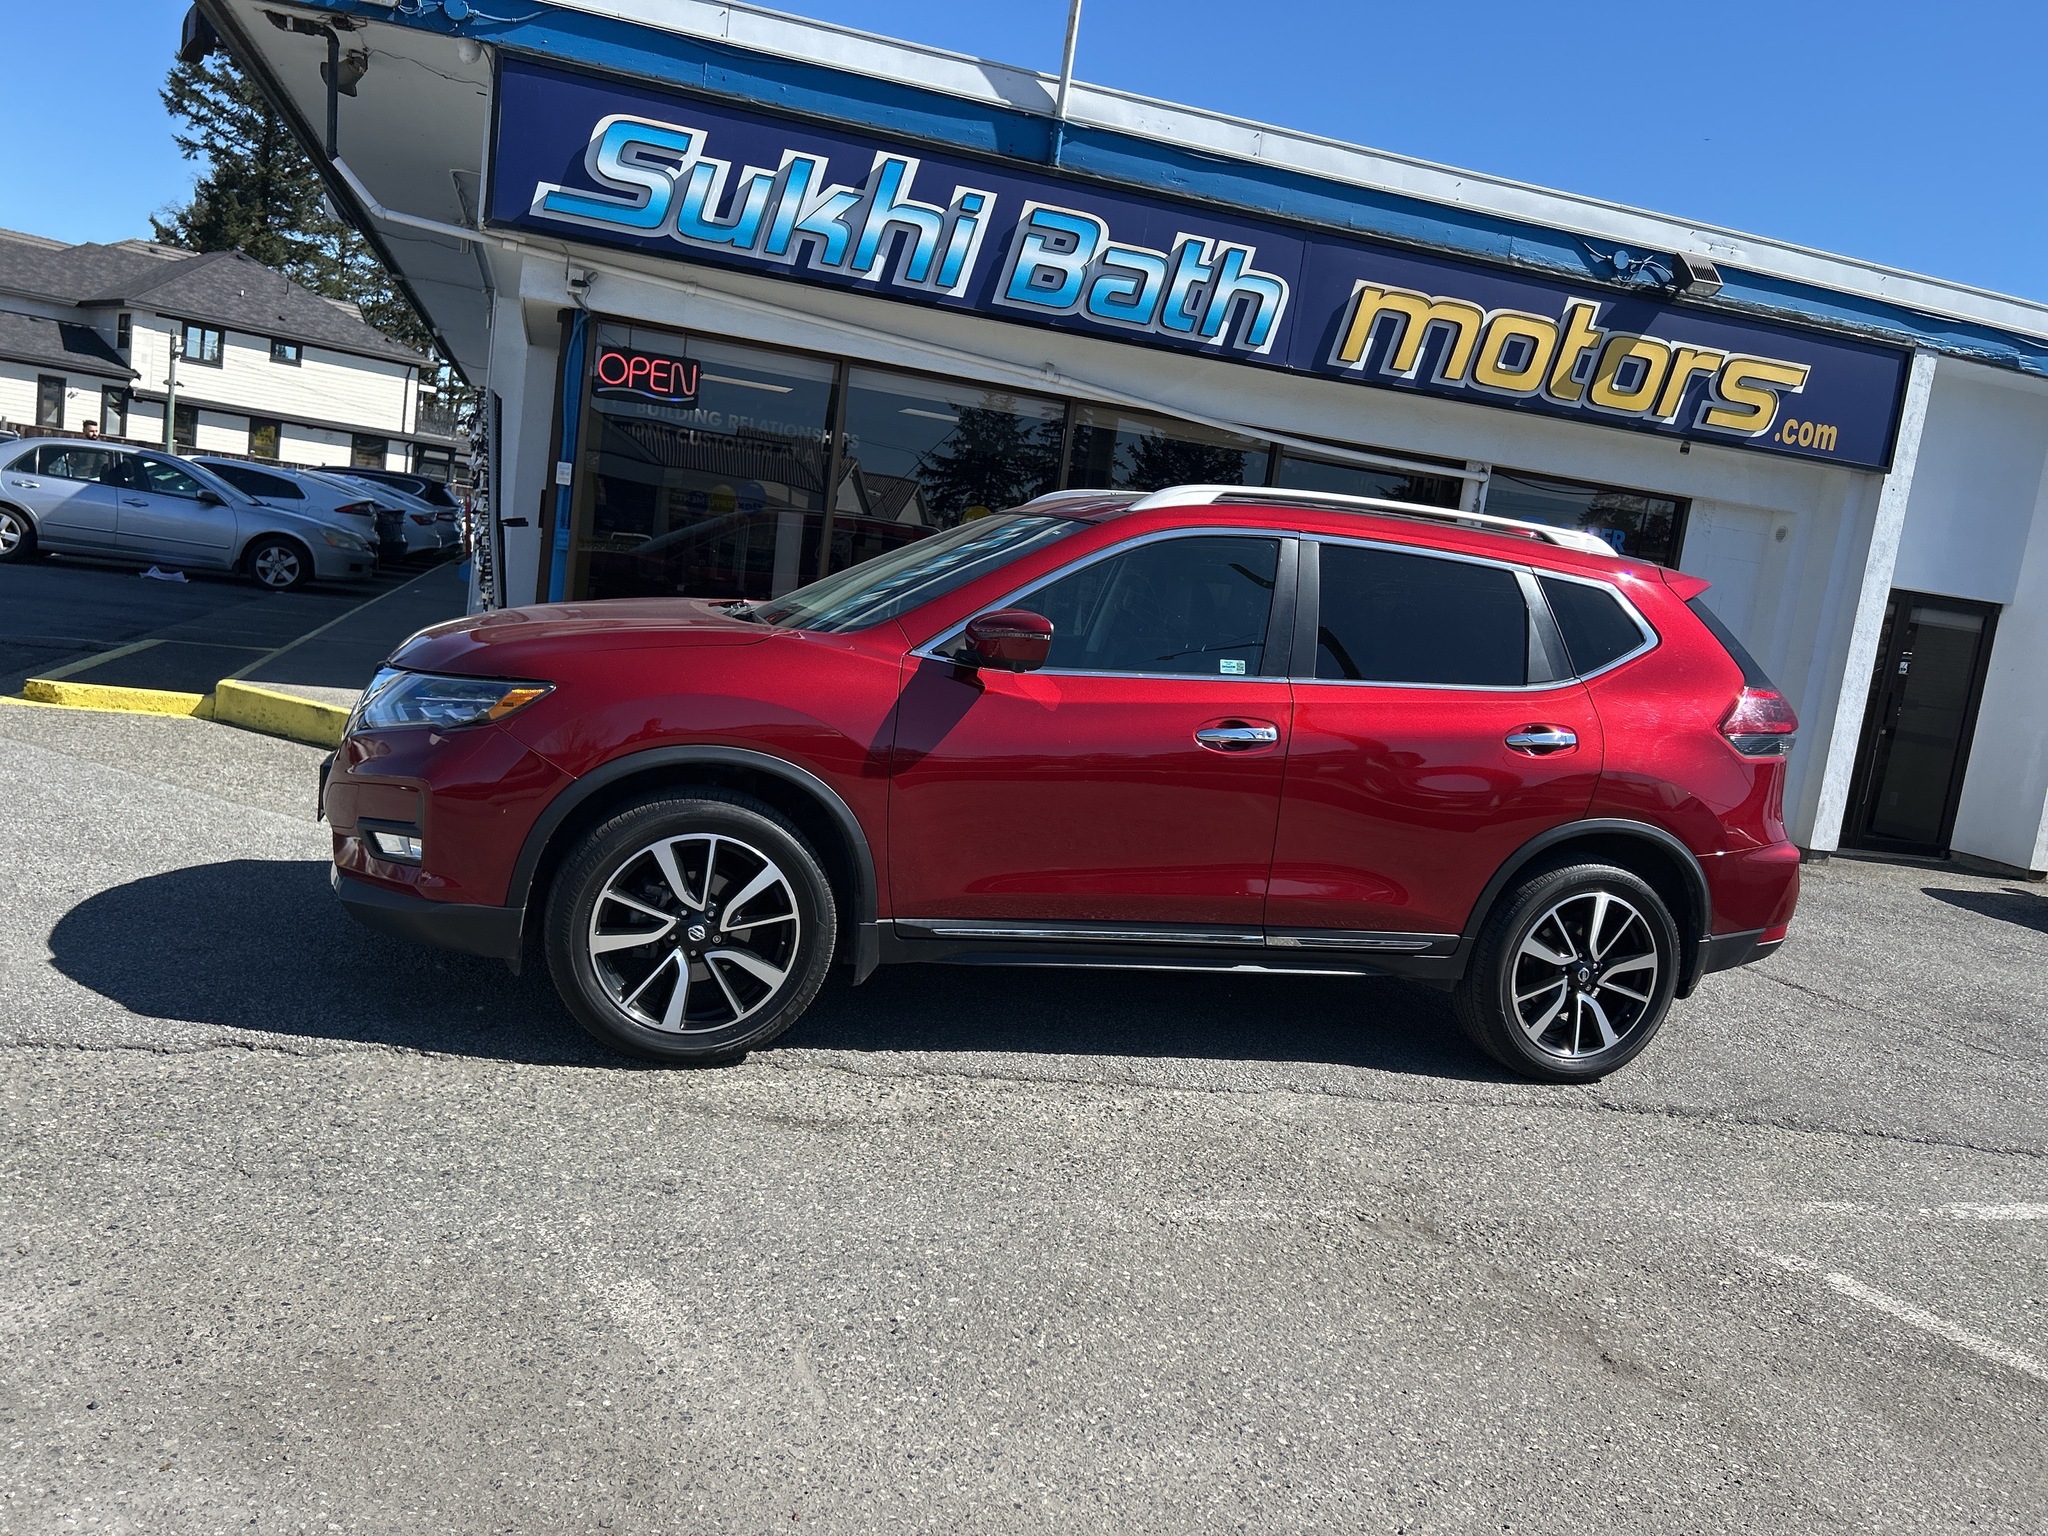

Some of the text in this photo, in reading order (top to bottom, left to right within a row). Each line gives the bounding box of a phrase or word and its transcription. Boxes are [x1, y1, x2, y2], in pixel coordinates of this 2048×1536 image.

[530, 114, 1837, 452] Sukhi Bath motors .com
[598, 352, 698, 396] OPEN
[636, 403, 860, 449] BUILDING RELATIONSHPS
[1569, 871, 1646, 892] BRIDGESTONE
